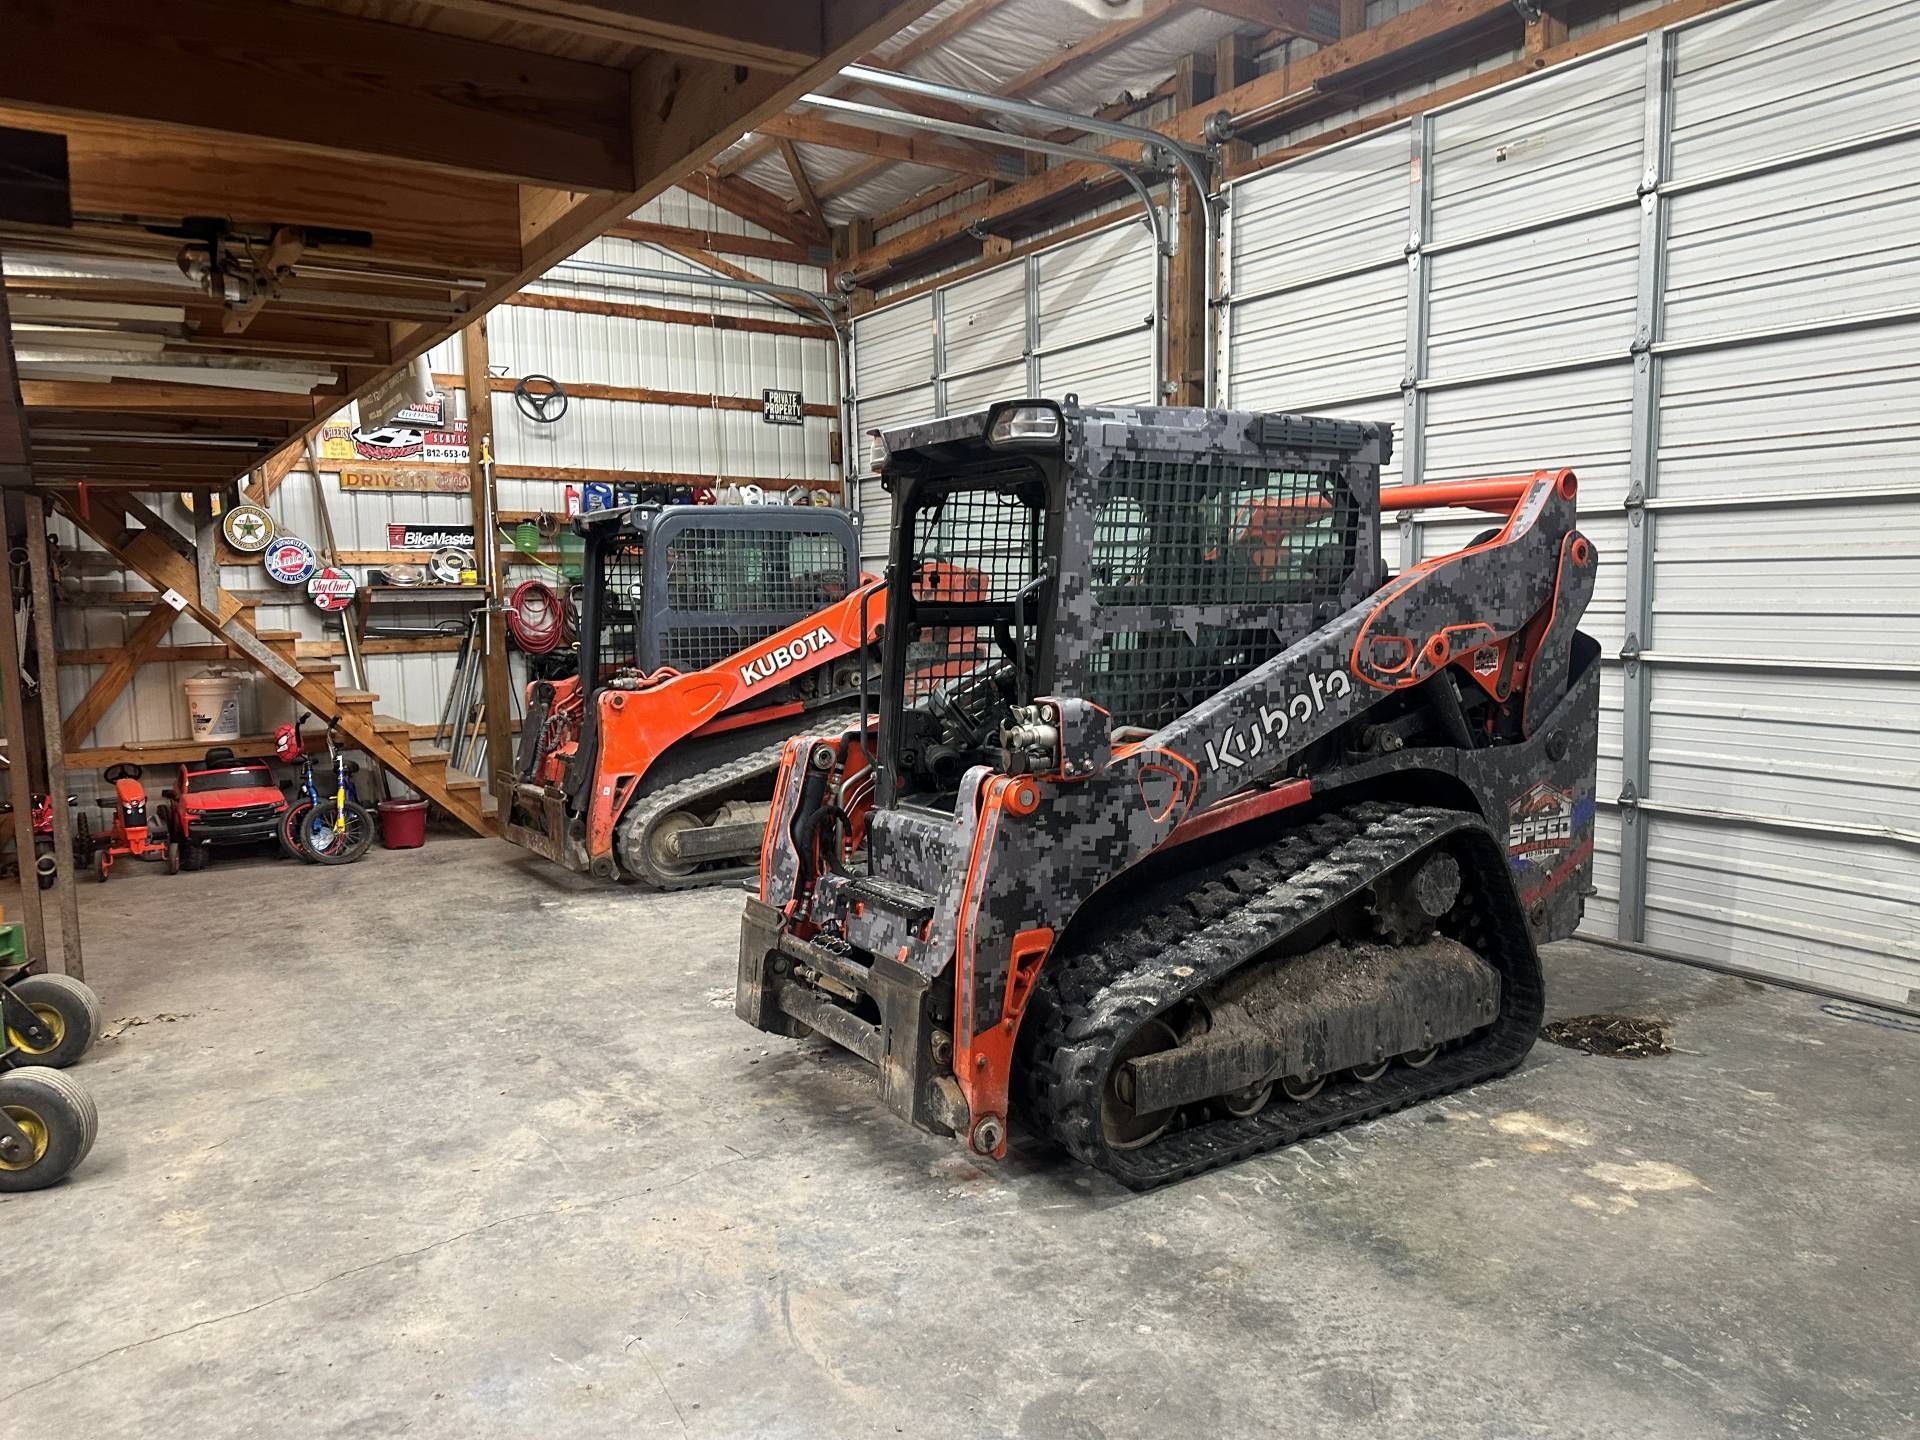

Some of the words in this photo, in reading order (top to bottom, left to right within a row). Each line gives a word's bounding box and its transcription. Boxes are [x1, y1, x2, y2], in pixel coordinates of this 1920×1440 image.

[769, 392, 797, 406] PRIVATE
[410, 402, 440, 413] OWNER
[765, 403, 801, 416] PROPERTY
[454, 422, 469, 432] AUC
[433, 434, 467, 444] SERVIC
[404, 532, 474, 545] BikeMaster
[312, 580, 328, 593] Sky
[328, 580, 351, 592] Chief
[740, 626, 835, 687] KUBOTA
[1204, 669, 1351, 772] Kubota
[1508, 817, 1571, 847] SPEED
